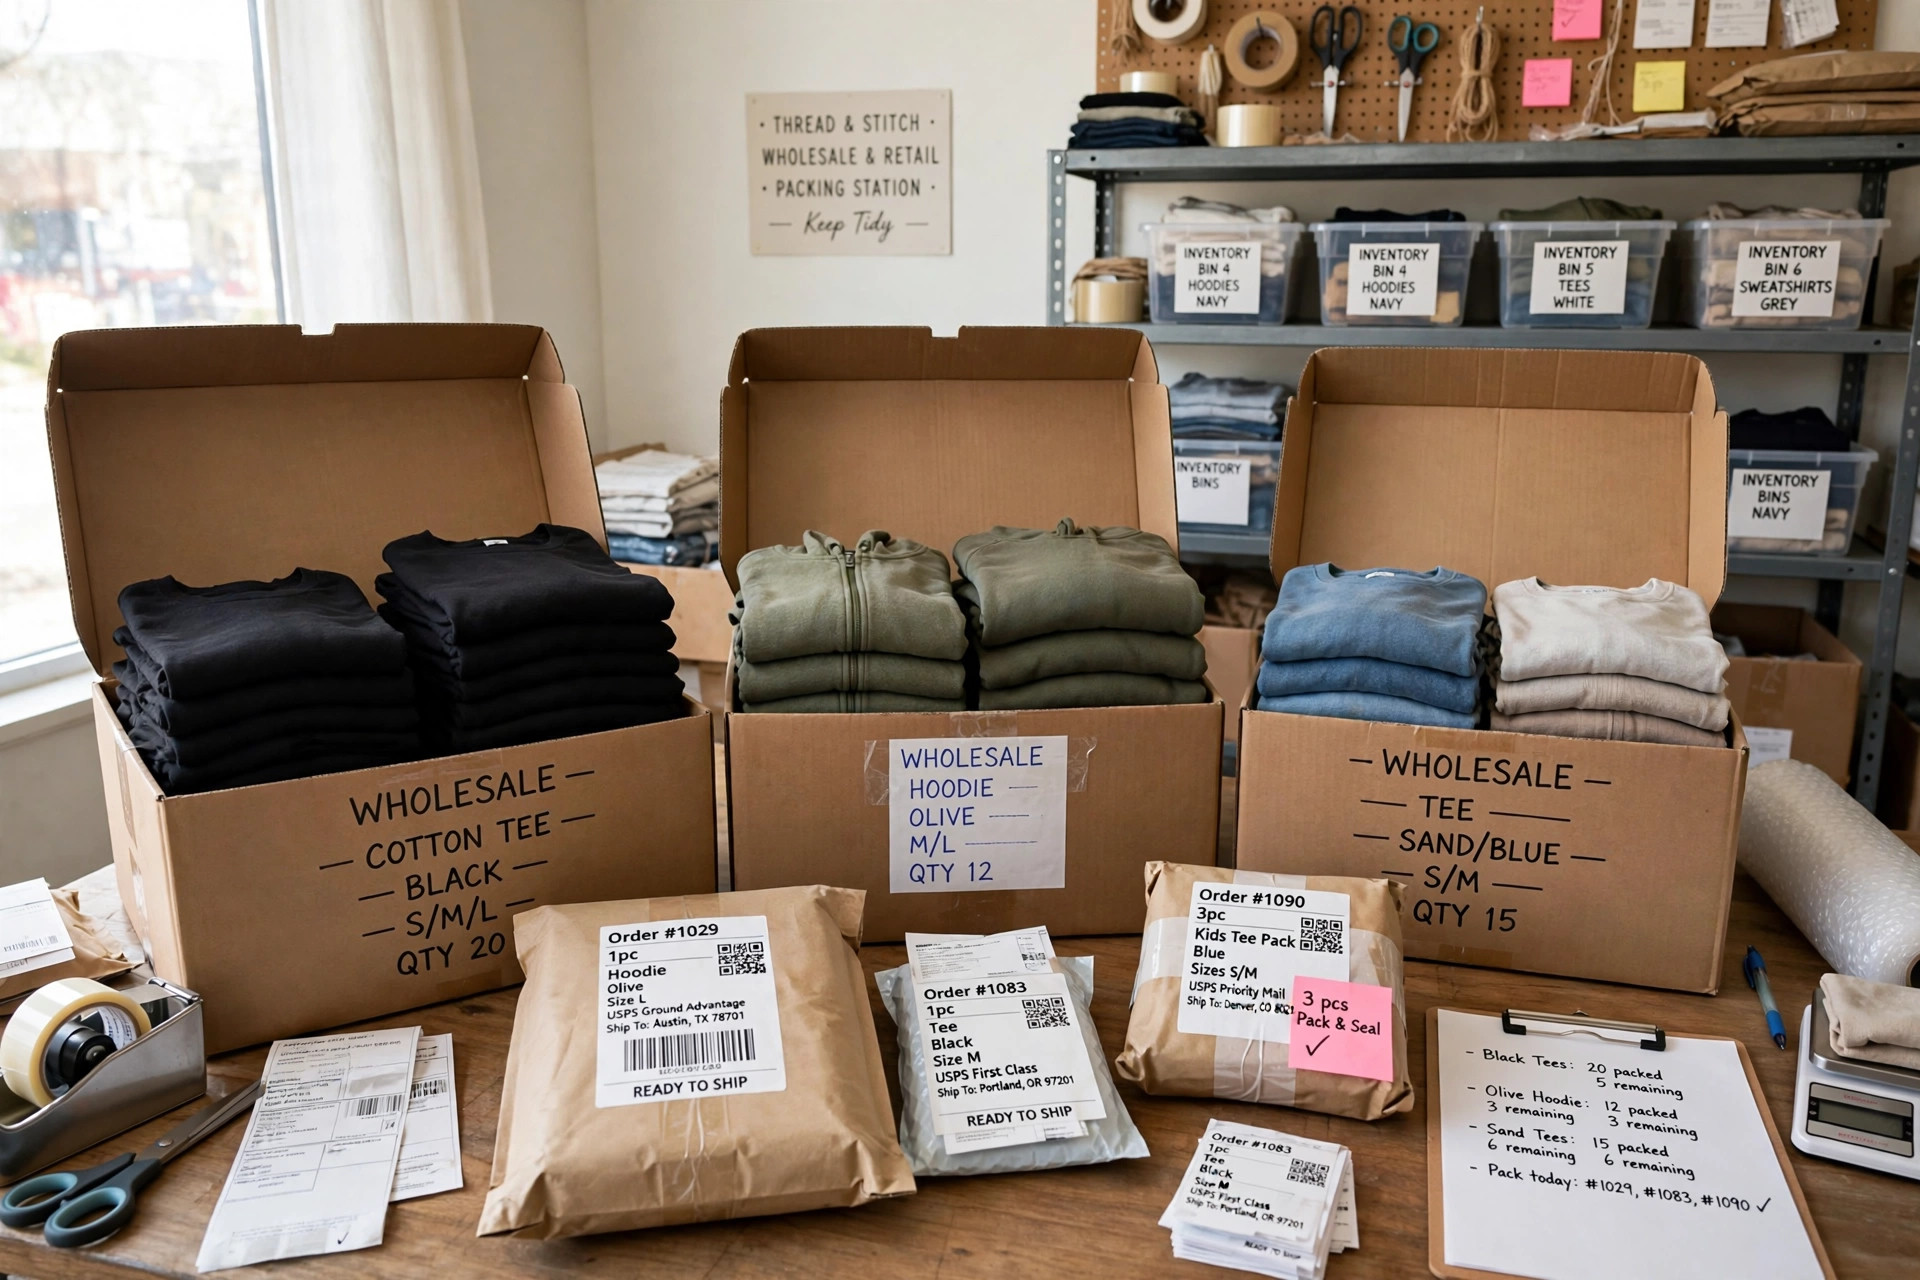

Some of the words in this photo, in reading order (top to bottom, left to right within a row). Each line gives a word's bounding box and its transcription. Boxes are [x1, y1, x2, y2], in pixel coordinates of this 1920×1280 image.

[774, 115, 835, 133] THREAD
[844, 116, 854, 132] &
[863, 114, 919, 132] STITCH
[762, 147, 857, 165] WHOLESALE
[866, 147, 874, 164] &
[884, 146, 939, 164] RETAIL
[776, 180, 844, 197] PACKING
[853, 179, 920, 197] STATION
[804, 211, 845, 241] Keep
[853, 210, 893, 243] Tidy
[1184, 248, 1251, 259] INVENTORY
[1359, 249, 1429, 261] INVENTORY
[1544, 246, 1618, 259] INVENTORY
[1748, 245, 1827, 259] INVENTORY
[1198, 263, 1218, 275] BIN
[1222, 263, 1229, 274] 4
[1373, 265, 1395, 277] BIN
[1399, 266, 1406, 277] 4
[1558, 262, 1582, 275] BIN
[1585, 263, 1593, 275] 5
[1765, 262, 1789, 275] BIN
[1793, 262, 1802, 275] 6
[1188, 279, 1239, 291] HOODIES
[1362, 281, 1415, 293] HOODIES
[1559, 279, 1590, 292] TEES
[1739, 279, 1833, 294] SWEATSHIRTS
[1196, 296, 1229, 308] NAVY
[1370, 298, 1403, 310] NAVY
[1554, 296, 1594, 309] WHITE
[1761, 297, 1798, 310] GREY
[1177, 462, 1241, 474] INVENTORY
[1742, 474, 1819, 487] INVENTORY
[1758, 491, 1790, 503] BINS
[1752, 507, 1790, 520] NAVY
[901, 746, 1043, 769] WHOLESALE
[1382, 748, 1574, 790] WHOLESALE
[349, 764, 556, 826] WHOLESALE
[910, 778, 994, 799] HOODIE
[909, 807, 975, 827] OLIVE
[1419, 794, 1474, 822] TEE
[366, 824, 482, 870] COTTON
[496, 810, 550, 843] TEE
[910, 831, 956, 858] M/L
[1399, 828, 1561, 865] SAND/BLUE
[405, 859, 503, 901] BLACK
[909, 863, 955, 884] QTY
[968, 861, 993, 882] 12
[1423, 864, 1479, 894] S/M
[1199, 888, 1247, 903] Order
[1252, 893, 1305, 908] #1090
[406, 896, 498, 940] S/M/L
[1197, 907, 1226, 923] 3pc
[1413, 899, 1470, 927] QTY
[1486, 907, 1517, 932] 15
[608, 929, 659, 944] Order
[665, 923, 719, 939] #1029
[1195, 928, 1226, 942] Kids
[1231, 931, 1256, 945] Tee
[1261, 934, 1296, 949] Pack
[397, 942, 454, 976] QTY
[470, 932, 506, 960] 20
[609, 950, 638, 964] 1pc
[1193, 946, 1225, 959] Blue
[608, 965, 667, 980] Hoodie
[1191, 963, 1225, 977] Sizes
[1230, 965, 1257, 981] S/M
[608, 982, 644, 994] Olive
[924, 987, 971, 1000] Order
[976, 982, 1027, 995] #1083
[1189, 981, 1217, 993] USPS
[1219, 984, 1258, 1000] Priority
[1262, 988, 1285, 1000] Mail
[607, 1008, 638, 1019] USPS
[642, 1003, 683, 1016] Ground
[686, 1000, 746, 1011] Advantage
[608, 997, 634, 1007] Size
[639, 995, 646, 1003] L
[1187, 996, 1206, 1009] Ship
[1209, 998, 1222, 1008] To:
[1224, 1000, 1257, 1013] Denver,
[1260, 1002, 1271, 1012] CO
[1303, 991, 1314, 1006] 3
[1321, 997, 1348, 1013] pcs
[927, 1005, 955, 1019] 1pc
[606, 1024, 630, 1034] Ship
[634, 1021, 649, 1031] To:
[653, 1017, 692, 1029] Austin,
[695, 1015, 709, 1024] TX
[712, 1011, 744, 1022] 78701
[929, 1022, 958, 1034] Tee
[1297, 1012, 1330, 1029] Pack
[1335, 1017, 1346, 1030] &
[1351, 1020, 1380, 1035] Seal
[931, 1036, 973, 1051] Black
[933, 1055, 962, 1067] Size
[968, 1051, 981, 1063] M
[1483, 1049, 1525, 1064] Black
[1532, 1055, 1574, 1069] Tees:
[1587, 1063, 1606, 1074] 20
[1614, 1066, 1663, 1081] packed
[935, 1071, 969, 1084] USPS
[973, 1068, 1003, 1079] First
[1005, 1064, 1038, 1076] Class
[634, 1083, 683, 1098] READY
[688, 1080, 708, 1093] TO
[713, 1076, 748, 1090] SHIP
[938, 1088, 960, 1099] Ship
[962, 1085, 977, 1095] To:
[980, 1080, 1025, 1093] Portland,
[1027, 1078, 1042, 1088] OR
[1044, 1075, 1075, 1086] 97201
[1596, 1077, 1606, 1087] 5
[1614, 1081, 1684, 1100] remaining
[1486, 1085, 1524, 1100] Olive
[1533, 1091, 1590, 1108] Hoodie:
[1605, 1101, 1621, 1112] 12
[1628, 1105, 1678, 1121] packed
[967, 1112, 1013, 1127] READY
[1016, 1109, 1037, 1122] TO
[1042, 1105, 1072, 1119] SHIP
[1487, 1102, 1497, 1112] 3
[1505, 1104, 1575, 1125] remaining
[1608, 1116, 1619, 1127] 3
[1627, 1120, 1698, 1141] remaining
[1209, 1143, 1230, 1153] 1pc
[1212, 1133, 1248, 1146] Order
[1252, 1141, 1292, 1154] #1083
[1487, 1123, 1524, 1139] Sand
[1533, 1130, 1575, 1144] Tees:
[1593, 1138, 1609, 1149] 15
[1618, 1141, 1669, 1158] packed
[1204, 1154, 1225, 1164] Tee
[1488, 1139, 1497, 1150] 6
[1506, 1143, 1576, 1165] remaining
[1604, 1155, 1614, 1166] 6
[1623, 1158, 1695, 1181] remaining
[1200, 1164, 1233, 1179] Black
[1489, 1164, 1524, 1181] Pack
[1529, 1170, 1578, 1192] today:
[1585, 1179, 1639, 1199] #1029,
[1644, 1186, 1698, 1207] #1083,
[1701, 1195, 1750, 1212] #1090
[1190, 1188, 1215, 1198] USPS
[1219, 1192, 1241, 1203] First
[1245, 1198, 1270, 1210] Class
[1186, 1197, 1203, 1207] Ship
[1220, 1204, 1259, 1221] Portland,
[1262, 1213, 1274, 1222] OR
[1277, 1217, 1304, 1229] 97201
